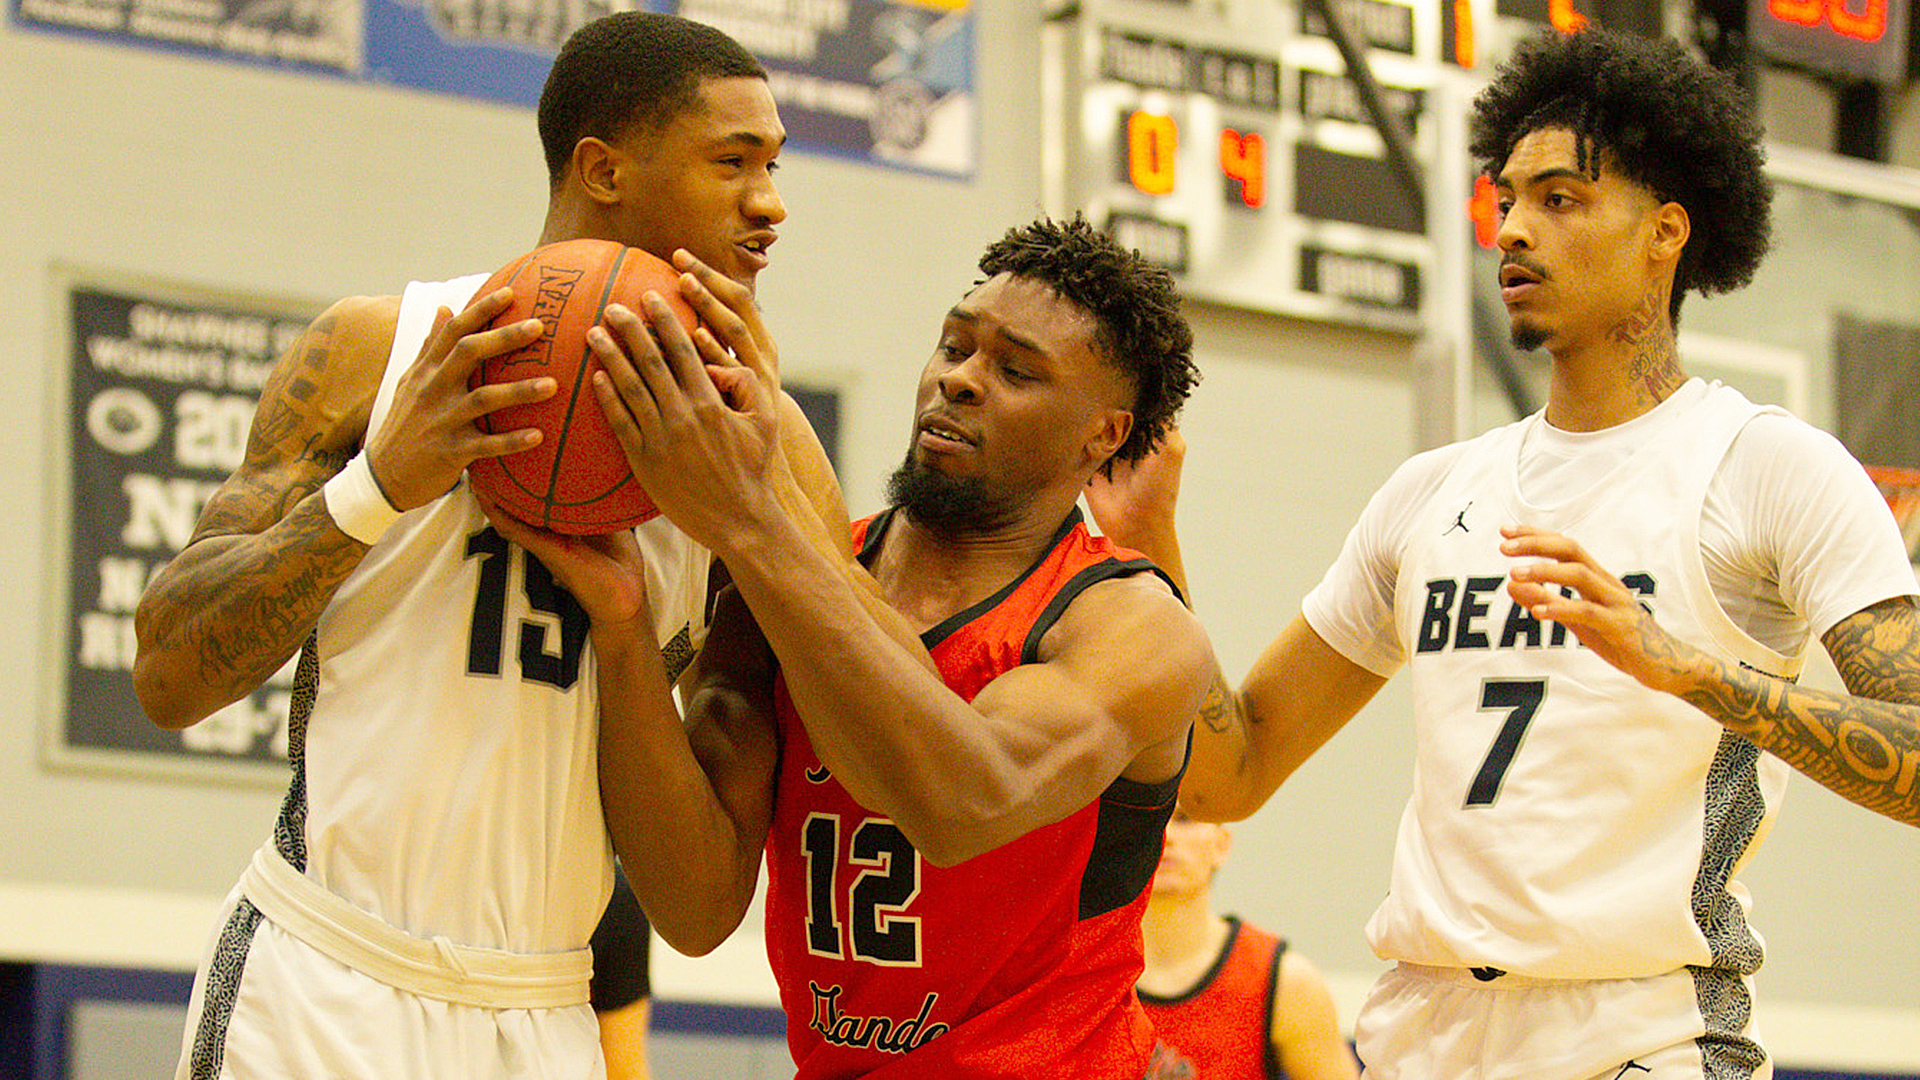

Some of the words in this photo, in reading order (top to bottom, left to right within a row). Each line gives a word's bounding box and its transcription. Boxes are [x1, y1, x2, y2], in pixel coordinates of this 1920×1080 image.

[1128, 110, 1177, 195] 0
[1219, 128, 1267, 208] 4
[464, 526, 591, 693] 15
[1461, 676, 1549, 810] 7
[801, 811, 923, 968] 12
